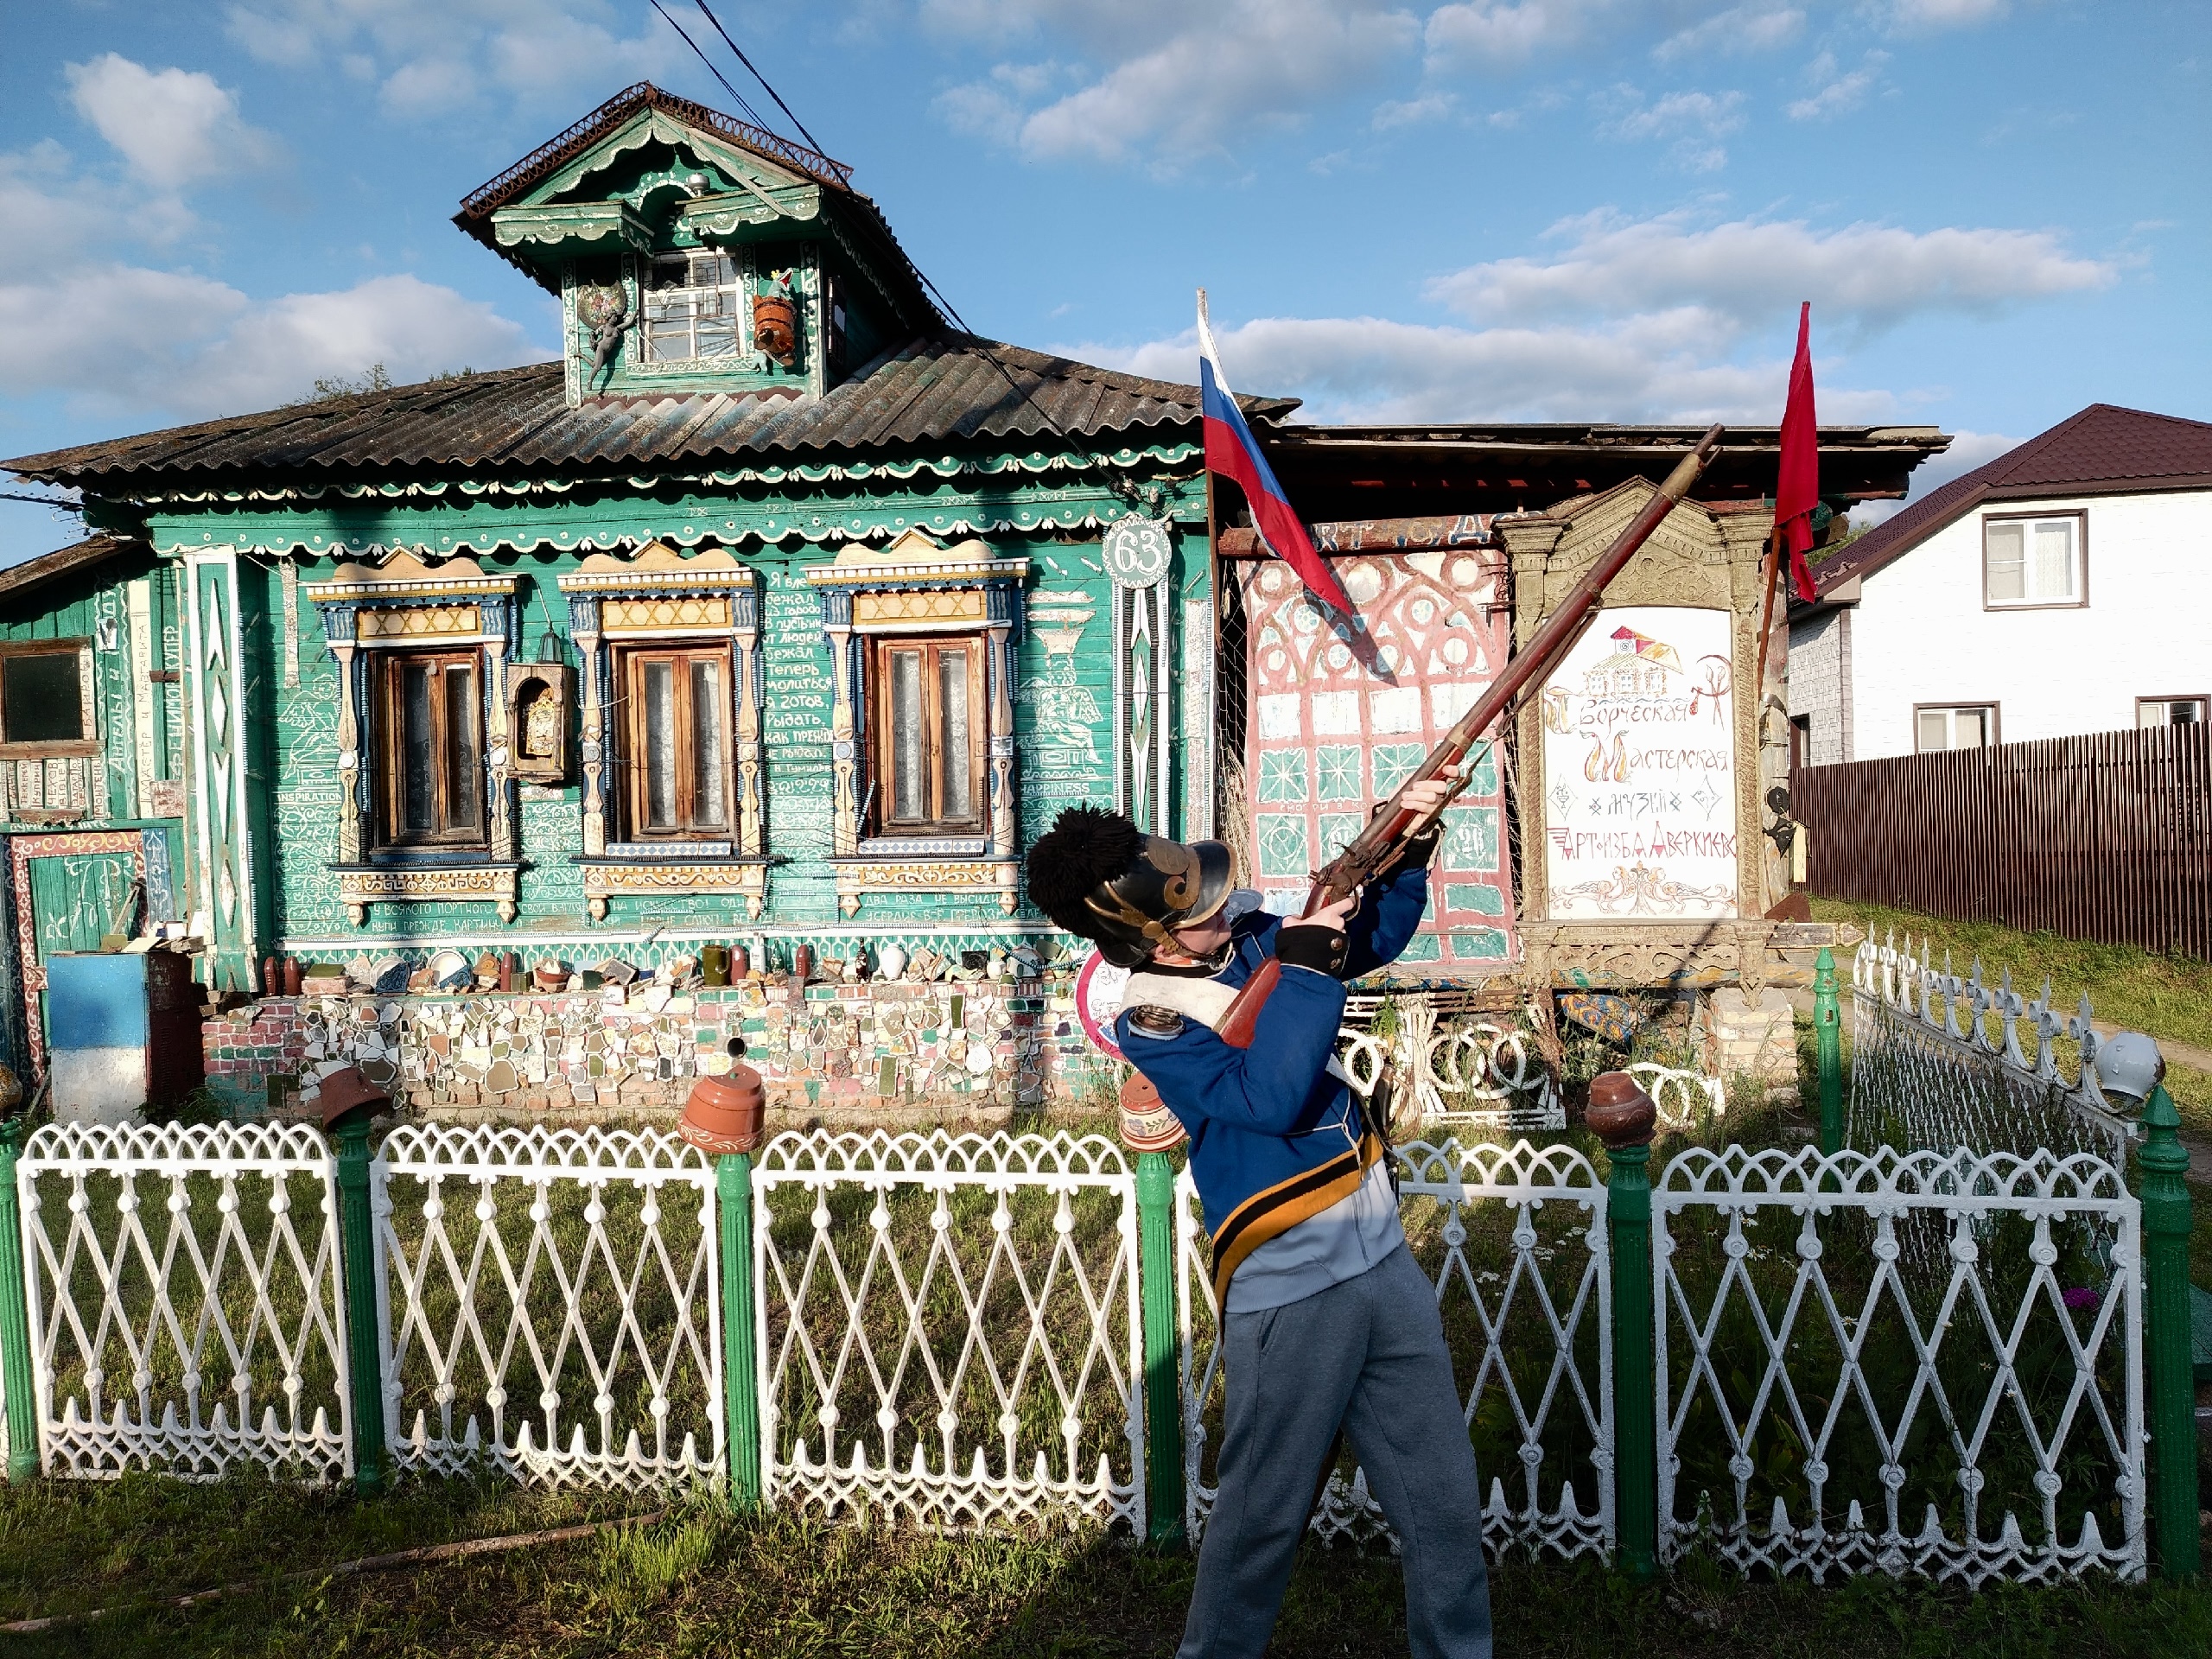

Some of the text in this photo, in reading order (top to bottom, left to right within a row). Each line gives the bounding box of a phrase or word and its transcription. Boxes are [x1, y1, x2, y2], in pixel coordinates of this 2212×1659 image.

[1115, 529, 1163, 576] 63
[770, 571, 781, 588] Я
[765, 592, 814, 605] бежал
[766, 662, 819, 677] Теперь
[766, 677, 832, 692] молиться
[48, 763, 58, 804] ЧЕХОВ
[1020, 782, 1090, 794] HAPPINESS
[276, 792, 343, 802] INSPIRATION
[385, 903, 432, 916] ВСЯКОГО
[437, 902, 493, 915] ПОРТНОГО
[865, 894, 888, 907] ДВА
[895, 894, 924, 905] РАЗА
[404, 919, 448, 932] ПРЕЖДЕ
